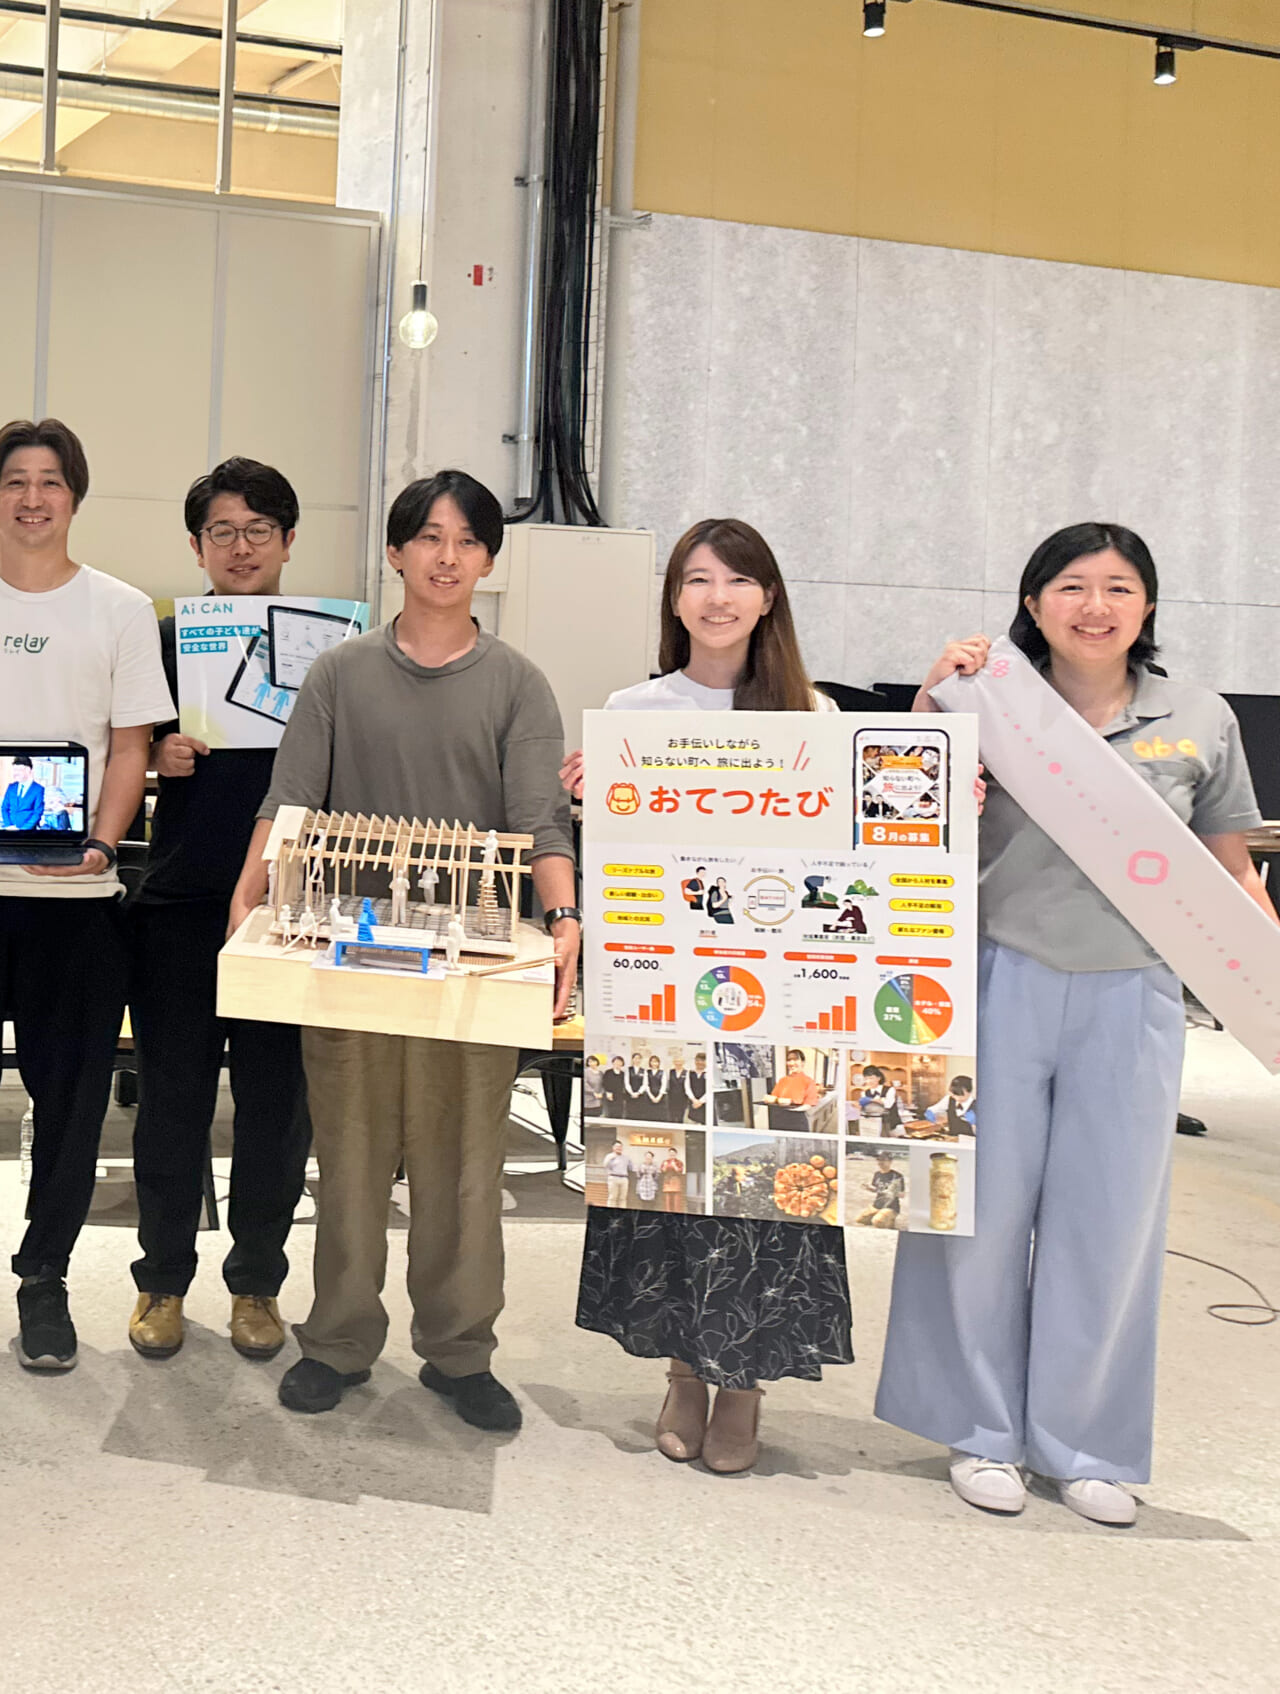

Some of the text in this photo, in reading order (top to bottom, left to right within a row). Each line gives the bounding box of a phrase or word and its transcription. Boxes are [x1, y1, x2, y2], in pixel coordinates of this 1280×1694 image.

[181, 602, 233, 616] Ai CAN
[180, 626, 261, 637] すべての子ども達が
[4, 633, 50, 654] relay
[182, 641, 227, 653] 安全な世界
[667, 738, 761, 750] お手伝いしながら
[640, 755, 784, 769] 知らない町へ 旅に出よう！
[648, 785, 834, 818] おてつたび
[872, 826, 931, 843] 8月の募集
[613, 958, 660, 971] 60,000
[800, 968, 839, 981] 1,600
